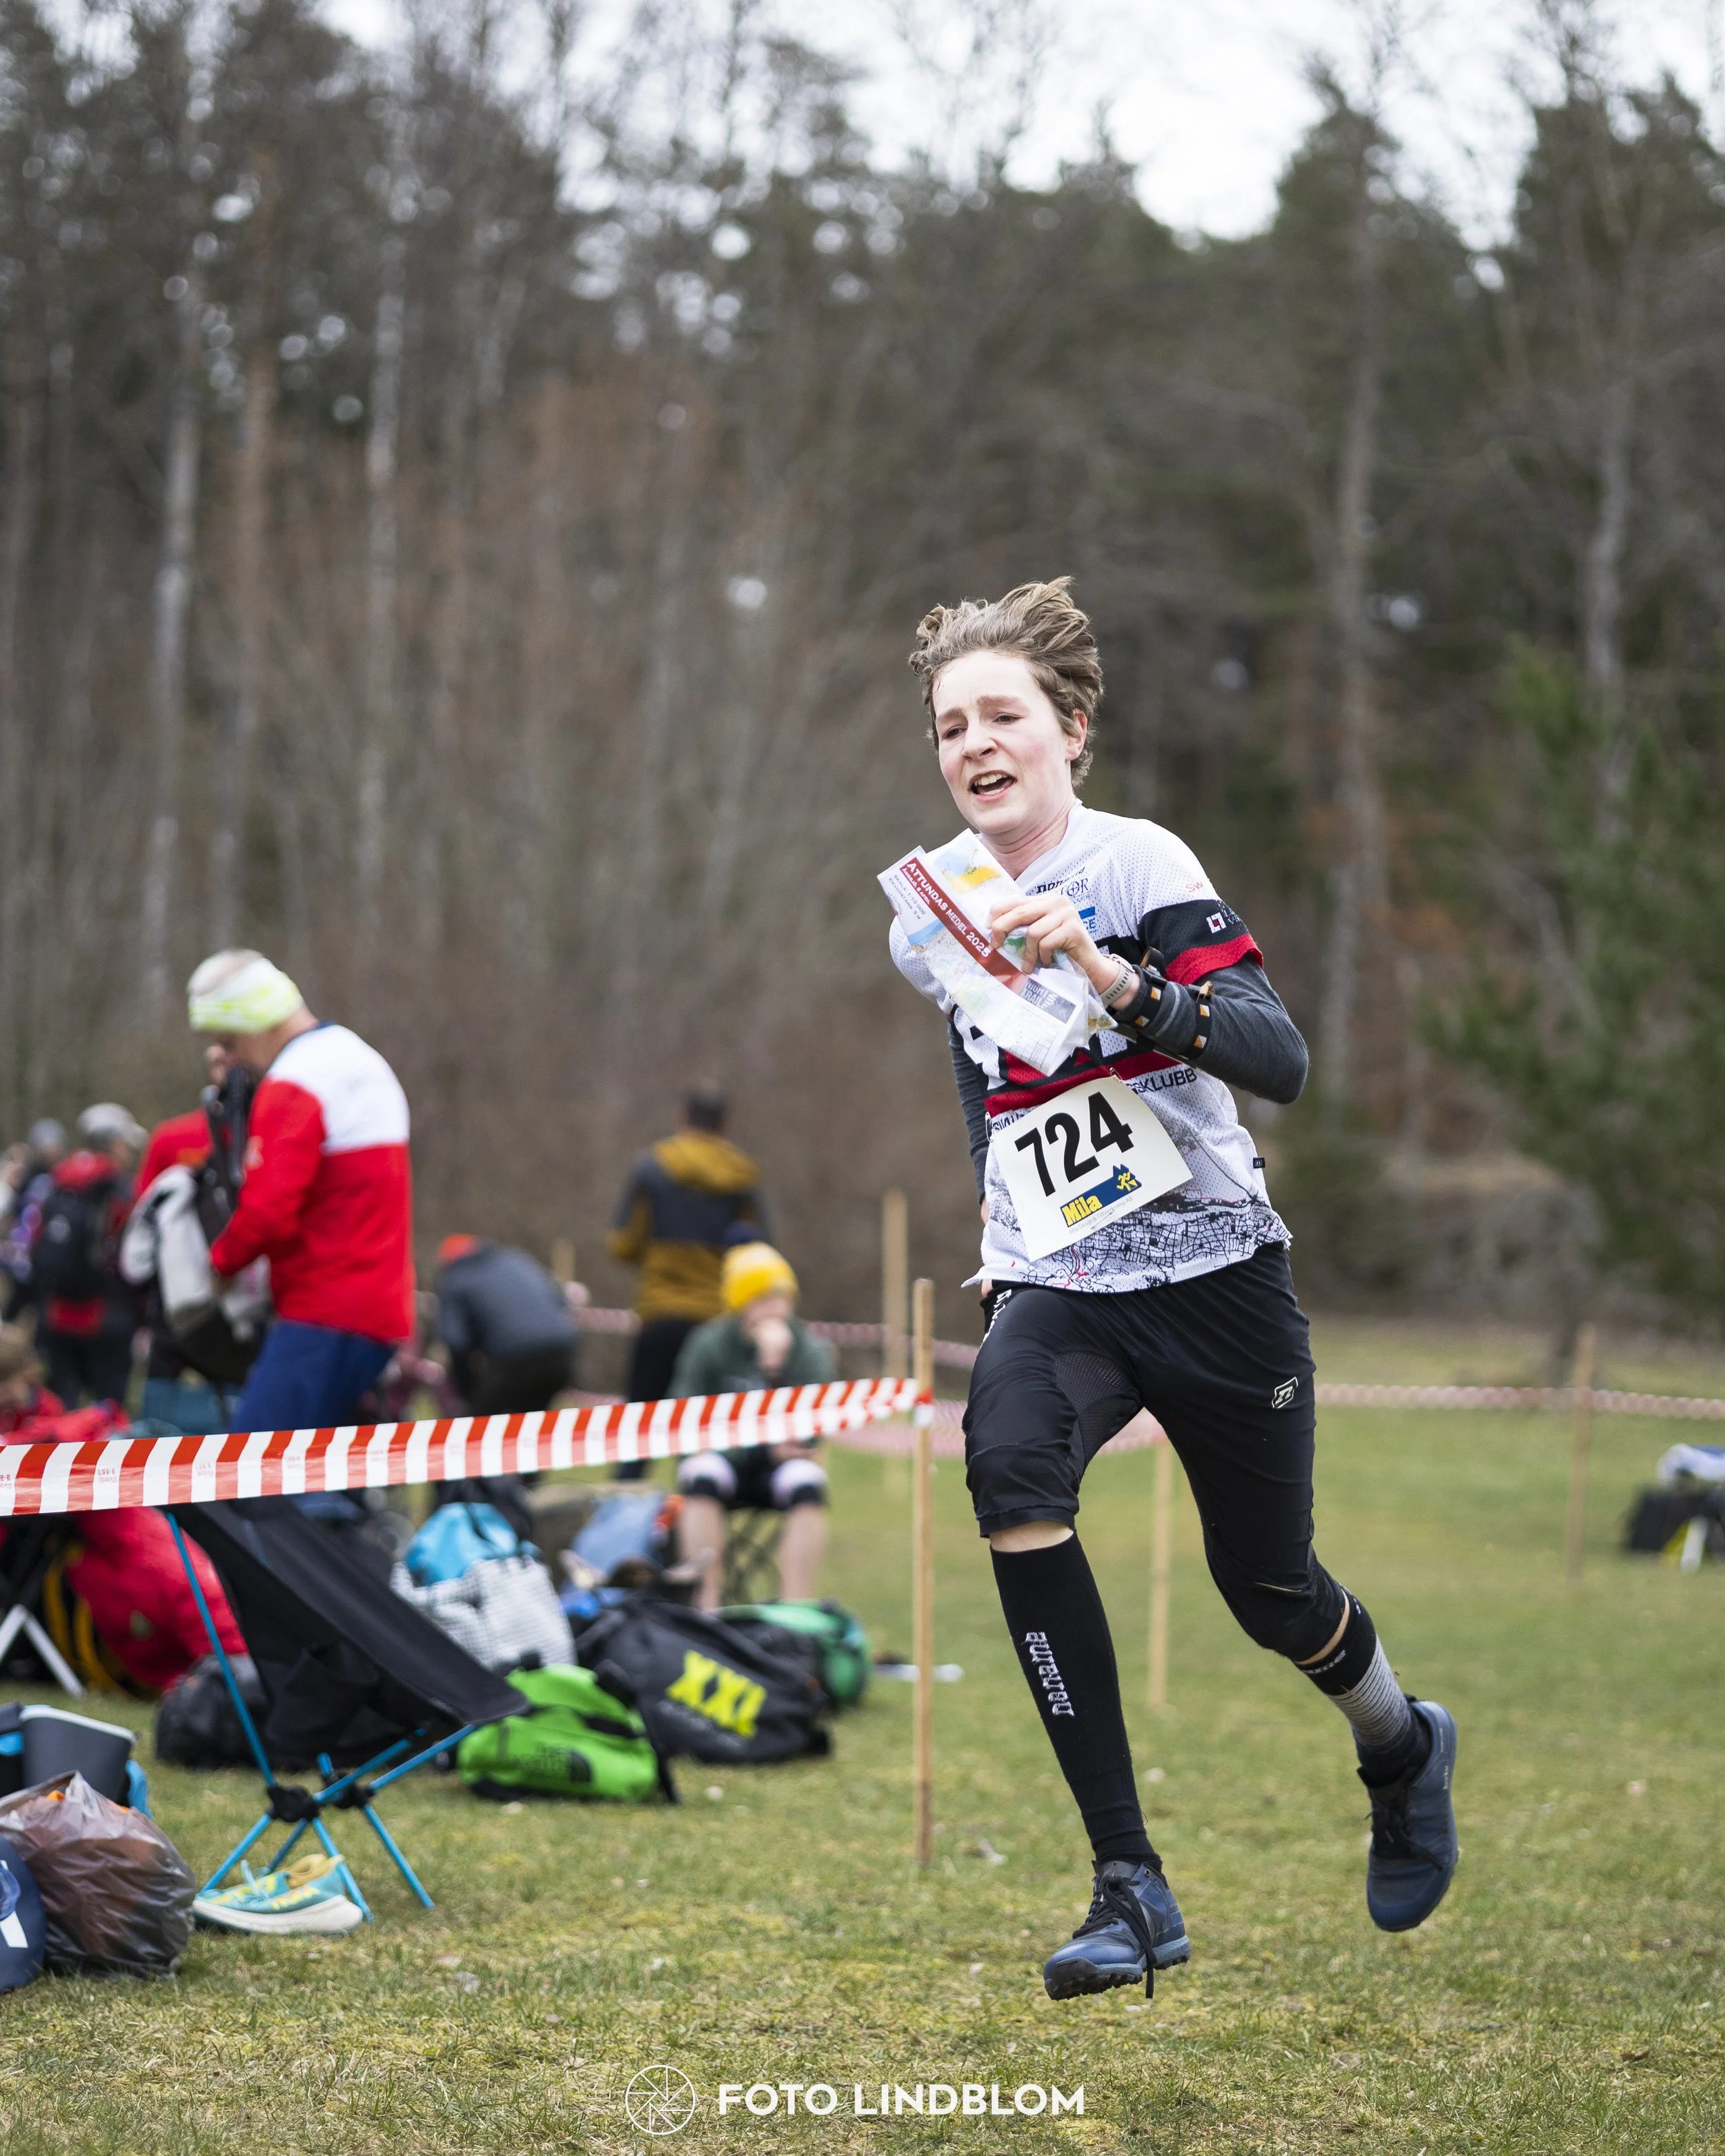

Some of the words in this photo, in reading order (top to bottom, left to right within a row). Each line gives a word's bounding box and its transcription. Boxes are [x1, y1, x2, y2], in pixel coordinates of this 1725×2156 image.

[907, 863, 948, 911] ATTUNDAS
[945, 909, 967, 935] MEDEL
[966, 931, 992, 957] 2025
[1014, 1091, 1134, 1198] 724
[1061, 1195, 1103, 1227] Mila
